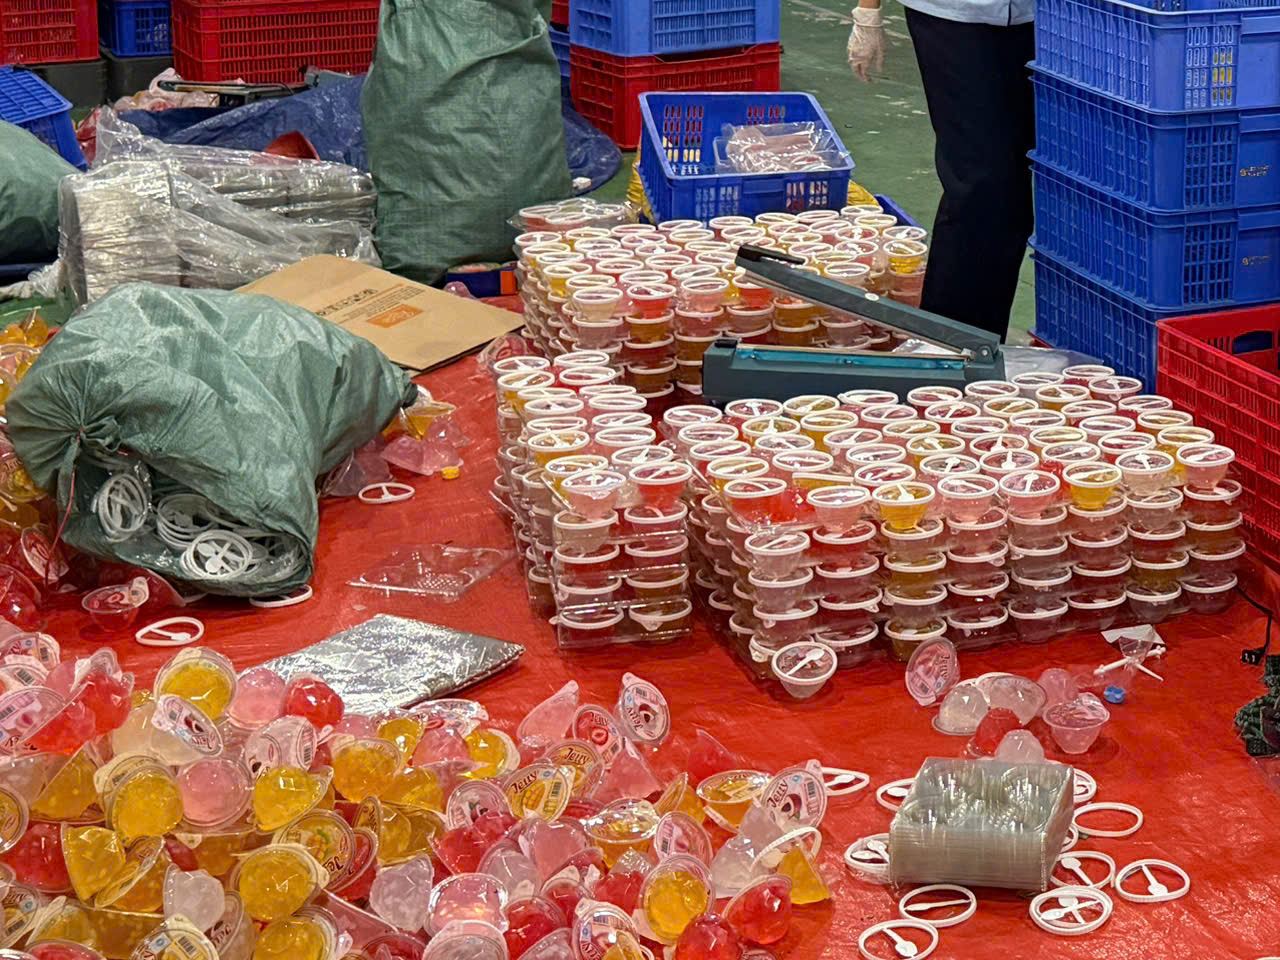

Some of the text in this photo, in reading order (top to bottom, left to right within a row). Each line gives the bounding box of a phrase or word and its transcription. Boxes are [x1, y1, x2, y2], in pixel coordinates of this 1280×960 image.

[564, 747, 590, 766] Jelly
[510, 770, 538, 795] Jelly
[766, 779, 789, 808] Jelly
